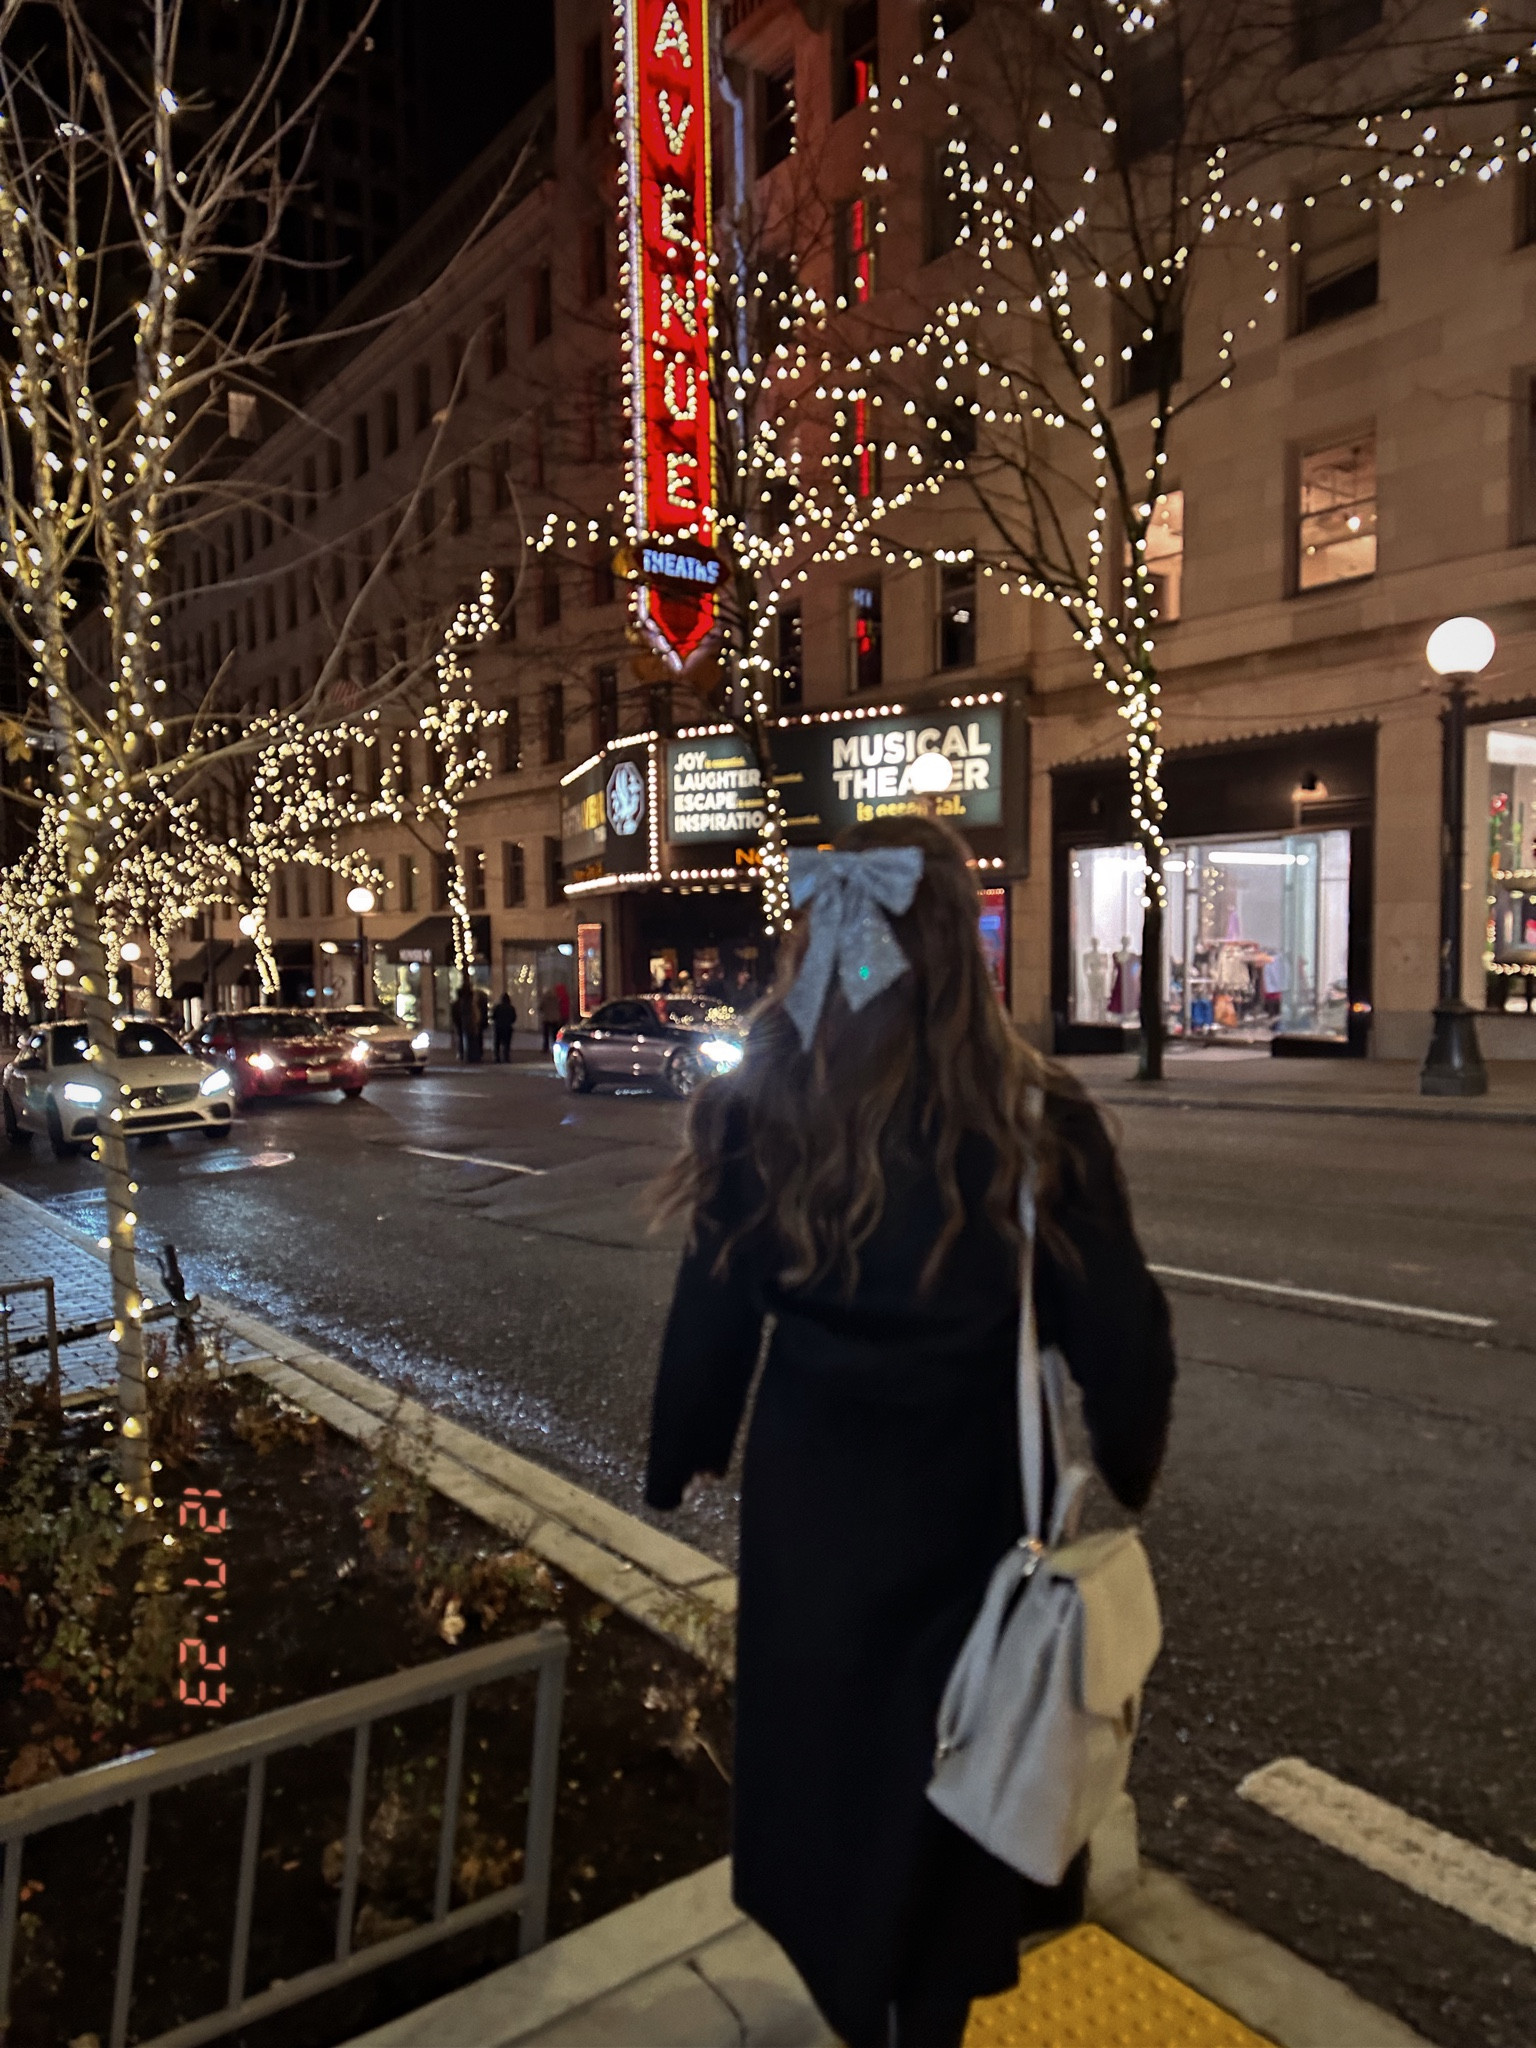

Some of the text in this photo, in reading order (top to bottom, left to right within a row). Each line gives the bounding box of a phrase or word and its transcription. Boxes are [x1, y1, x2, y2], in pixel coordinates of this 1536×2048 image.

[654, 1, 697, 508] AVENUE
[832, 722, 992, 769] MUSICAL
[674, 751, 707, 772] JOY
[674, 768, 762, 792] LAUGHTER
[832, 757, 990, 800] THEAER
[674, 791, 738, 812] ESCAPE
[856, 801, 874, 821] is
